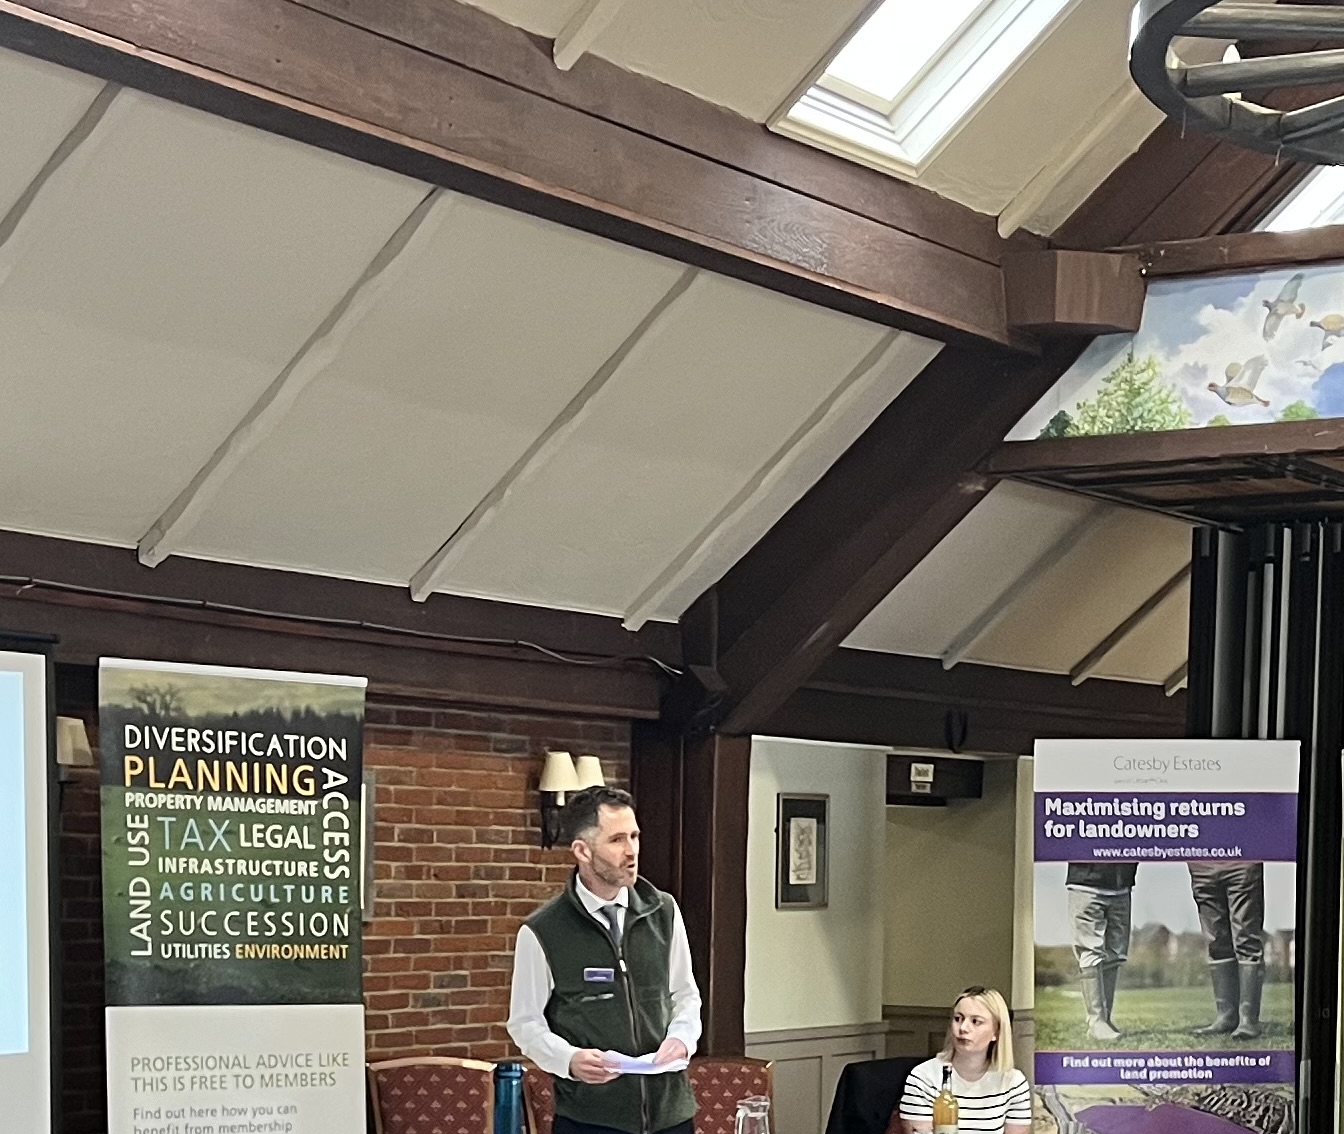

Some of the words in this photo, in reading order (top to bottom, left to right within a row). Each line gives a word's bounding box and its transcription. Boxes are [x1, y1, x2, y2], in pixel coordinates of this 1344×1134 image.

[124, 724, 347, 761] DIVERSIFICATION
[124, 755, 317, 796] PLANNING
[1113, 755, 1170, 774] Catesby
[1173, 756, 1222, 771] Estates
[125, 792, 203, 810] PROPERTY
[206, 796, 318, 816] MANAGEMENT
[1044, 798, 1166, 821] Maximising
[1170, 799, 1246, 816] returns
[157, 816, 232, 852] TAX
[239, 823, 316, 850] LEGAL
[321, 767, 350, 879] ACCESS
[1044, 820, 1075, 838] for
[1079, 820, 1199, 838] landowners
[127, 813, 151, 867] USE
[1093, 846, 1243, 859] www.catesbyestates.co.uk
[158, 857, 319, 877] INFRASTRUCTURE
[159, 882, 349, 904] AGRICULTURE
[129, 876, 153, 956] LAND
[160, 909, 350, 937] SUCCESSION
[160, 943, 231, 960] UTILITIES
[235, 943, 349, 960] ENVIRONMENT
[130, 1055, 251, 1073] PROFESSIONAL
[256, 1053, 313, 1070] ADVICE
[318, 1052, 349, 1068] LIKE
[1063, 1056, 1089, 1068] Find
[1091, 1057, 1112, 1068] out
[1113, 1058, 1145, 1068] more
[1146, 1056, 1182, 1068] about
[1184, 1056, 1204, 1067] the
[1205, 1055, 1257, 1067] benefits
[1258, 1055, 1271, 1067] of
[130, 1077, 168, 1094] THIS
[173, 1076, 186, 1092] IS
[190, 1075, 228, 1091] FREE
[233, 1074, 255, 1090] TO
[260, 1072, 337, 1089] MEMBERS
[1120, 1068, 1147, 1080] land
[1149, 1068, 1213, 1082] promotion
[133, 1107, 161, 1120] Find
[165, 1108, 186, 1120] out
[189, 1106, 217, 1118] here
[221, 1105, 248, 1118] how
[251, 1106, 274, 1119] you
[277, 1104, 298, 1116] can
[218, 1120, 293, 1134] membership
